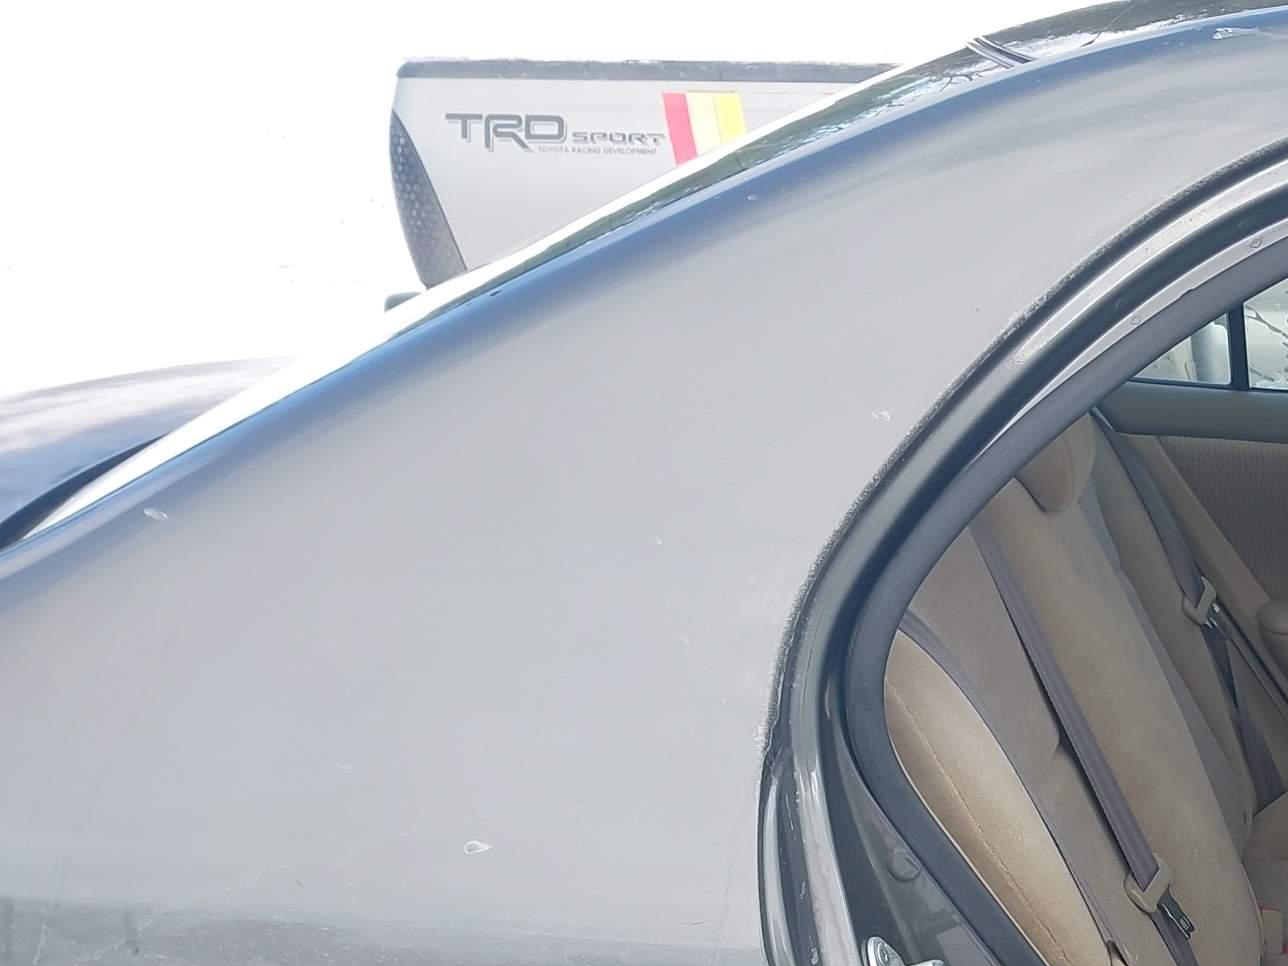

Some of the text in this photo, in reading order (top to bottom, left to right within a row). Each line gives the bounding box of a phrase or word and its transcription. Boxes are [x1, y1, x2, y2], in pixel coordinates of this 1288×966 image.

[445, 113, 666, 152] TRD SPORT
[603, 147, 657, 155] DEVELOPMENT
